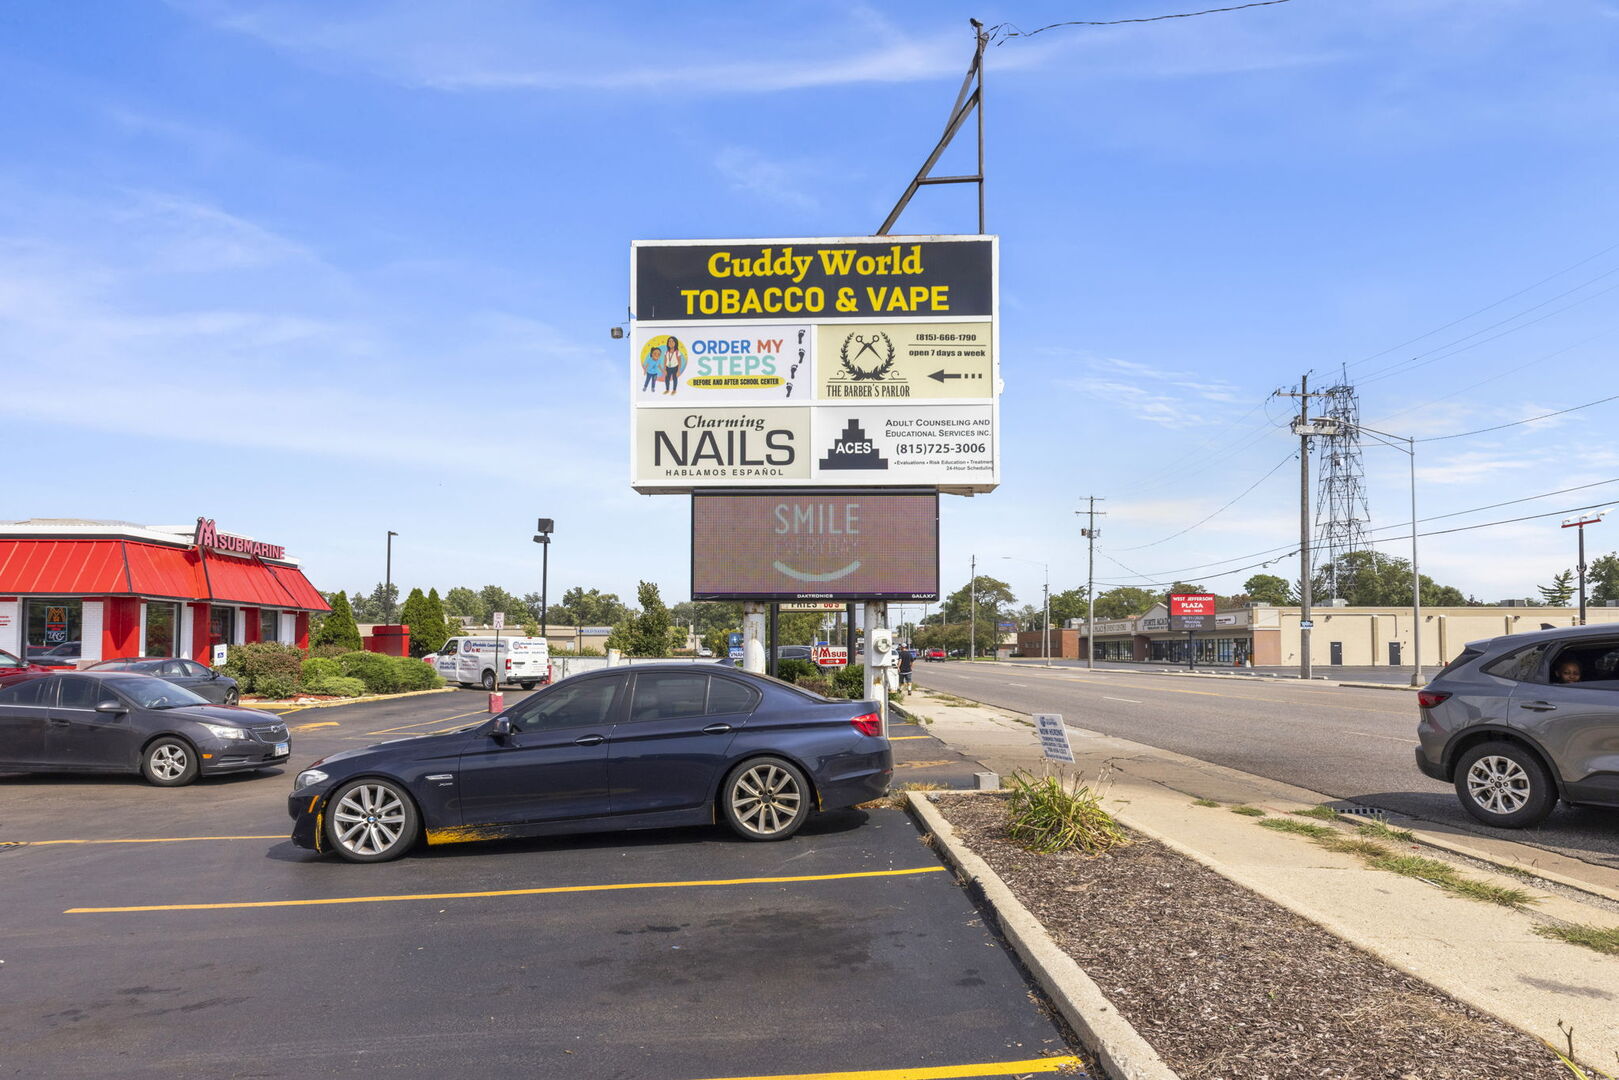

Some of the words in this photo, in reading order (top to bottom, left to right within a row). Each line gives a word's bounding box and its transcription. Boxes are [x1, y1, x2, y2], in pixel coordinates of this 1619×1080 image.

[707, 247, 814, 284] Cuddy
[817, 244, 924, 276] World
[681, 286, 825, 315] TOBACCO
[835, 286, 859, 313] &
[866, 285, 950, 312] VAPE
[915, 333, 977, 341] (815)-666-1790
[691, 339, 751, 355] ORDER
[757, 338, 784, 354] MY
[936, 349, 956, 357] days
[963, 349, 986, 357] week
[697, 354, 777, 377] STEPS
[740, 378, 759, 386] SCHOOL
[826, 384, 842, 397] THE
[844, 383, 880, 398] BARBER'S
[881, 384, 911, 398] PARLOR
[683, 414, 766, 432] Charming
[885, 419, 914, 427] ADULT
[915, 418, 971, 427] COUNSELING
[885, 429, 937, 438] EDUCATIONAL
[938, 429, 975, 437] SERVICES
[654, 429, 796, 467] NAILS
[835, 441, 874, 454] ACES
[895, 443, 986, 456] (815)725-3006
[665, 469, 727, 477] HABLAMOS
[732, 467, 784, 476] ESPAÑOL
[774, 503, 861, 535] SMILE
[219, 534, 286, 560] SUBMARINE
